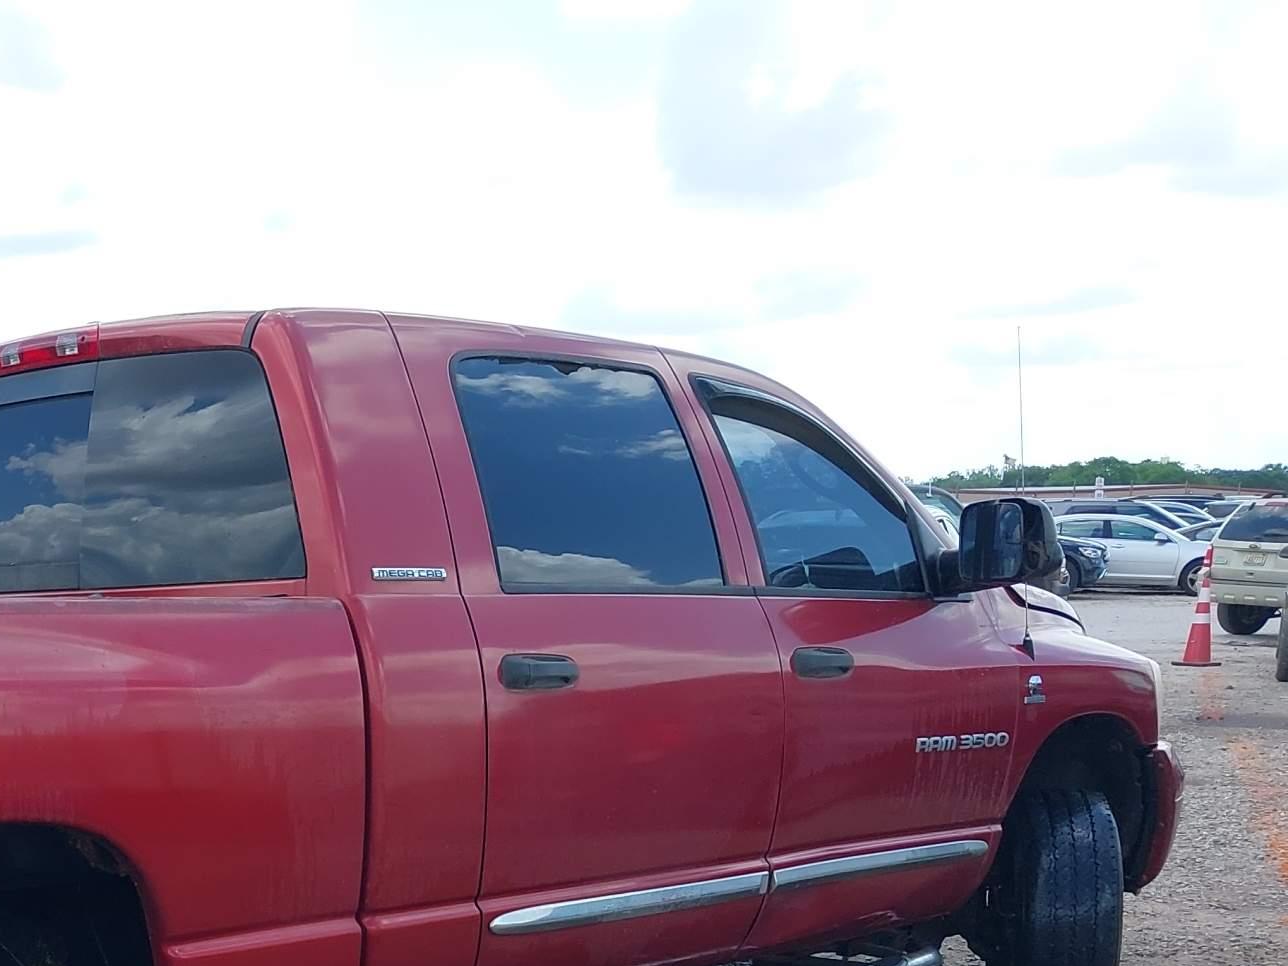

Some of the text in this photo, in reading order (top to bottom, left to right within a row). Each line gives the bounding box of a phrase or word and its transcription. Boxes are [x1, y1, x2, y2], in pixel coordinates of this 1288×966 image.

[377, 569, 444, 578] MEGA CAB
[915, 731, 1010, 753] RAM 3500
